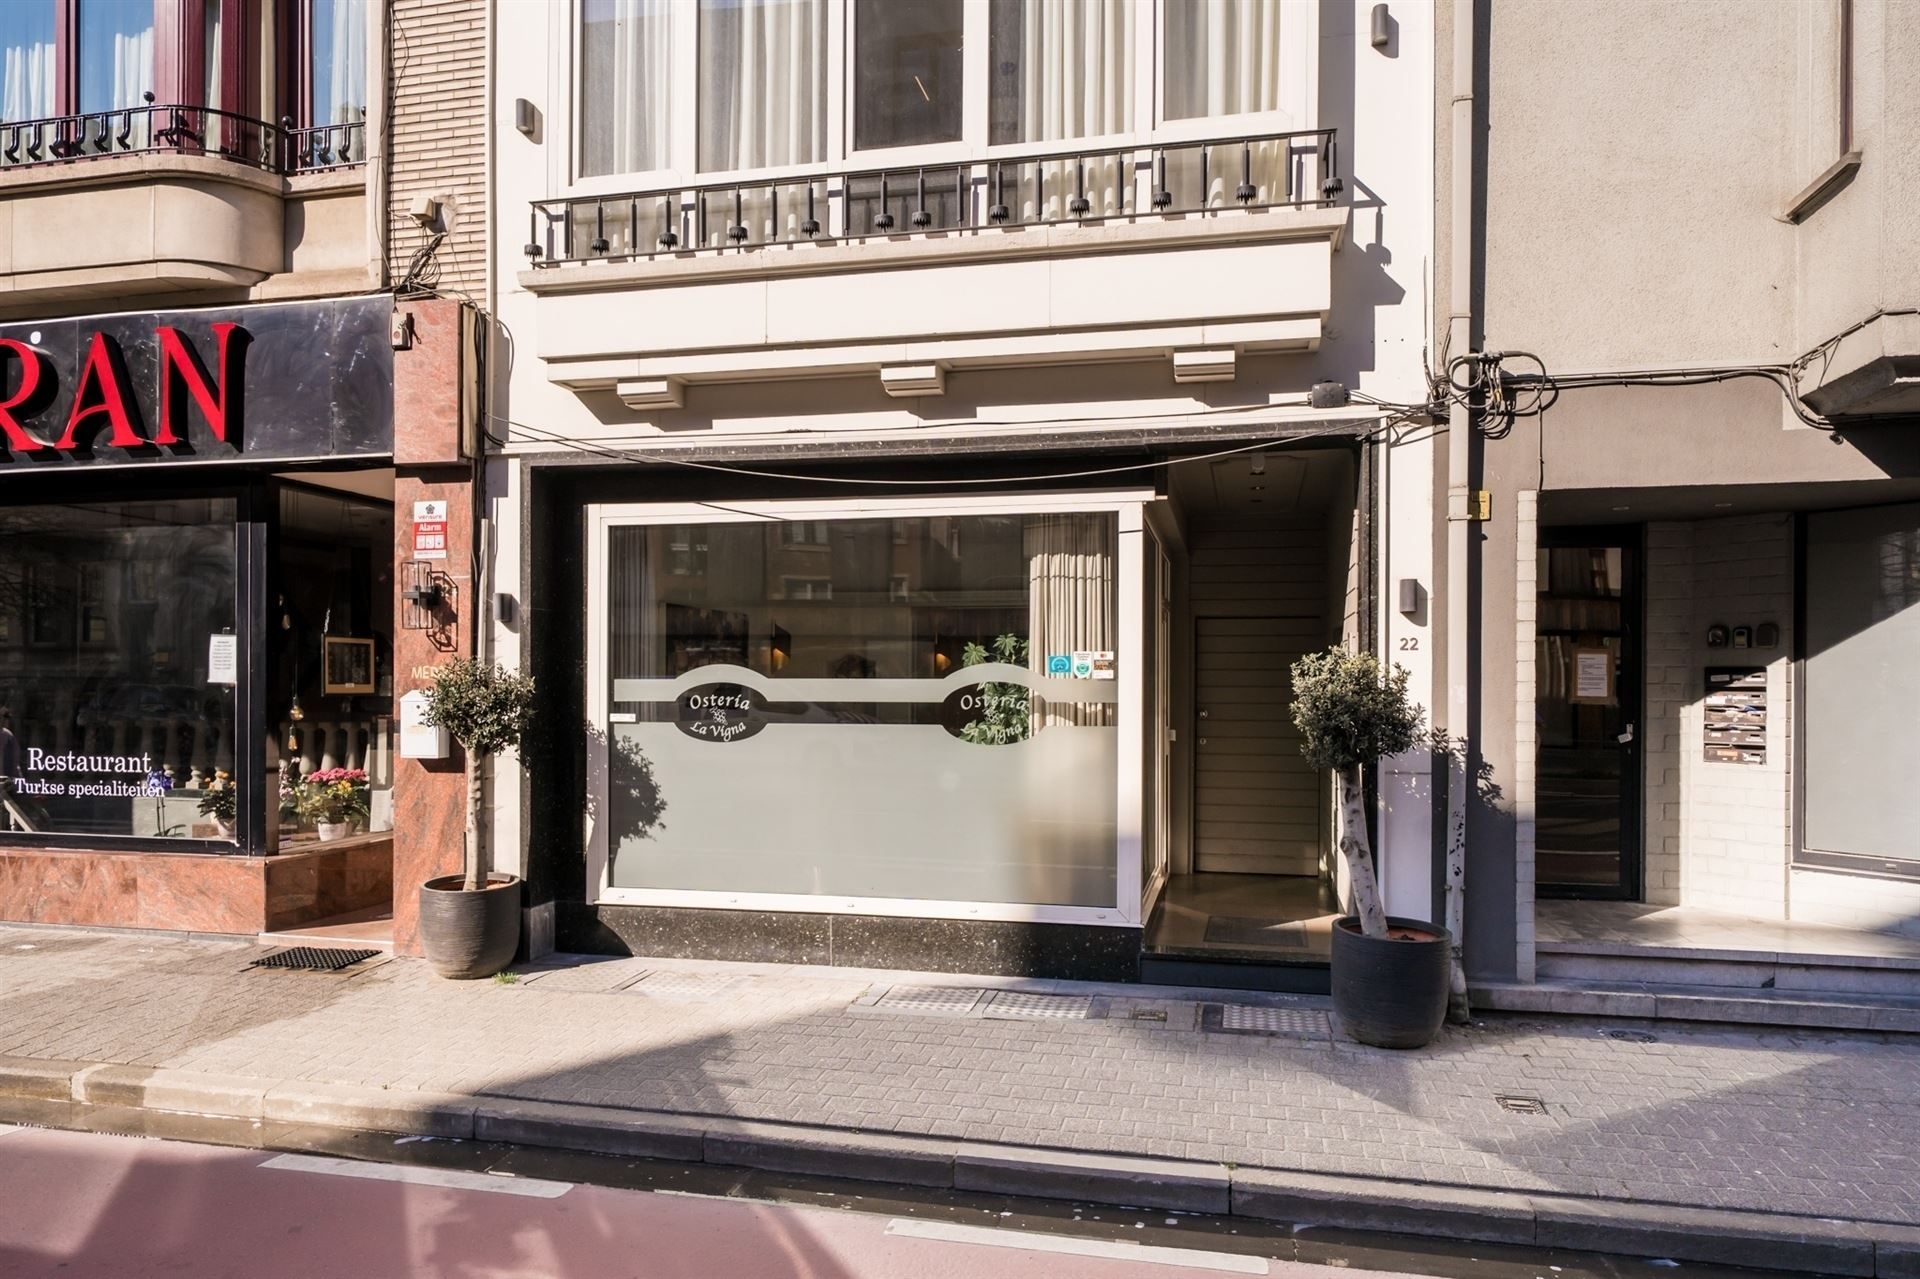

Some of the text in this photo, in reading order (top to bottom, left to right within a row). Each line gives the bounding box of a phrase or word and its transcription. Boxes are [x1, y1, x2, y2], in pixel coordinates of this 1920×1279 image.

[418, 523, 442, 532] Alarm
[1400, 637, 1419, 651] 22
[690, 694, 750, 710] Osteria
[960, 694, 1027, 711] Osteria
[690, 721, 746, 742] La Vigna
[980, 723, 1023, 744] Vigna
[27, 747, 152, 773] Restaurant
[15, 777, 165, 798] Turkse specialiteiten
